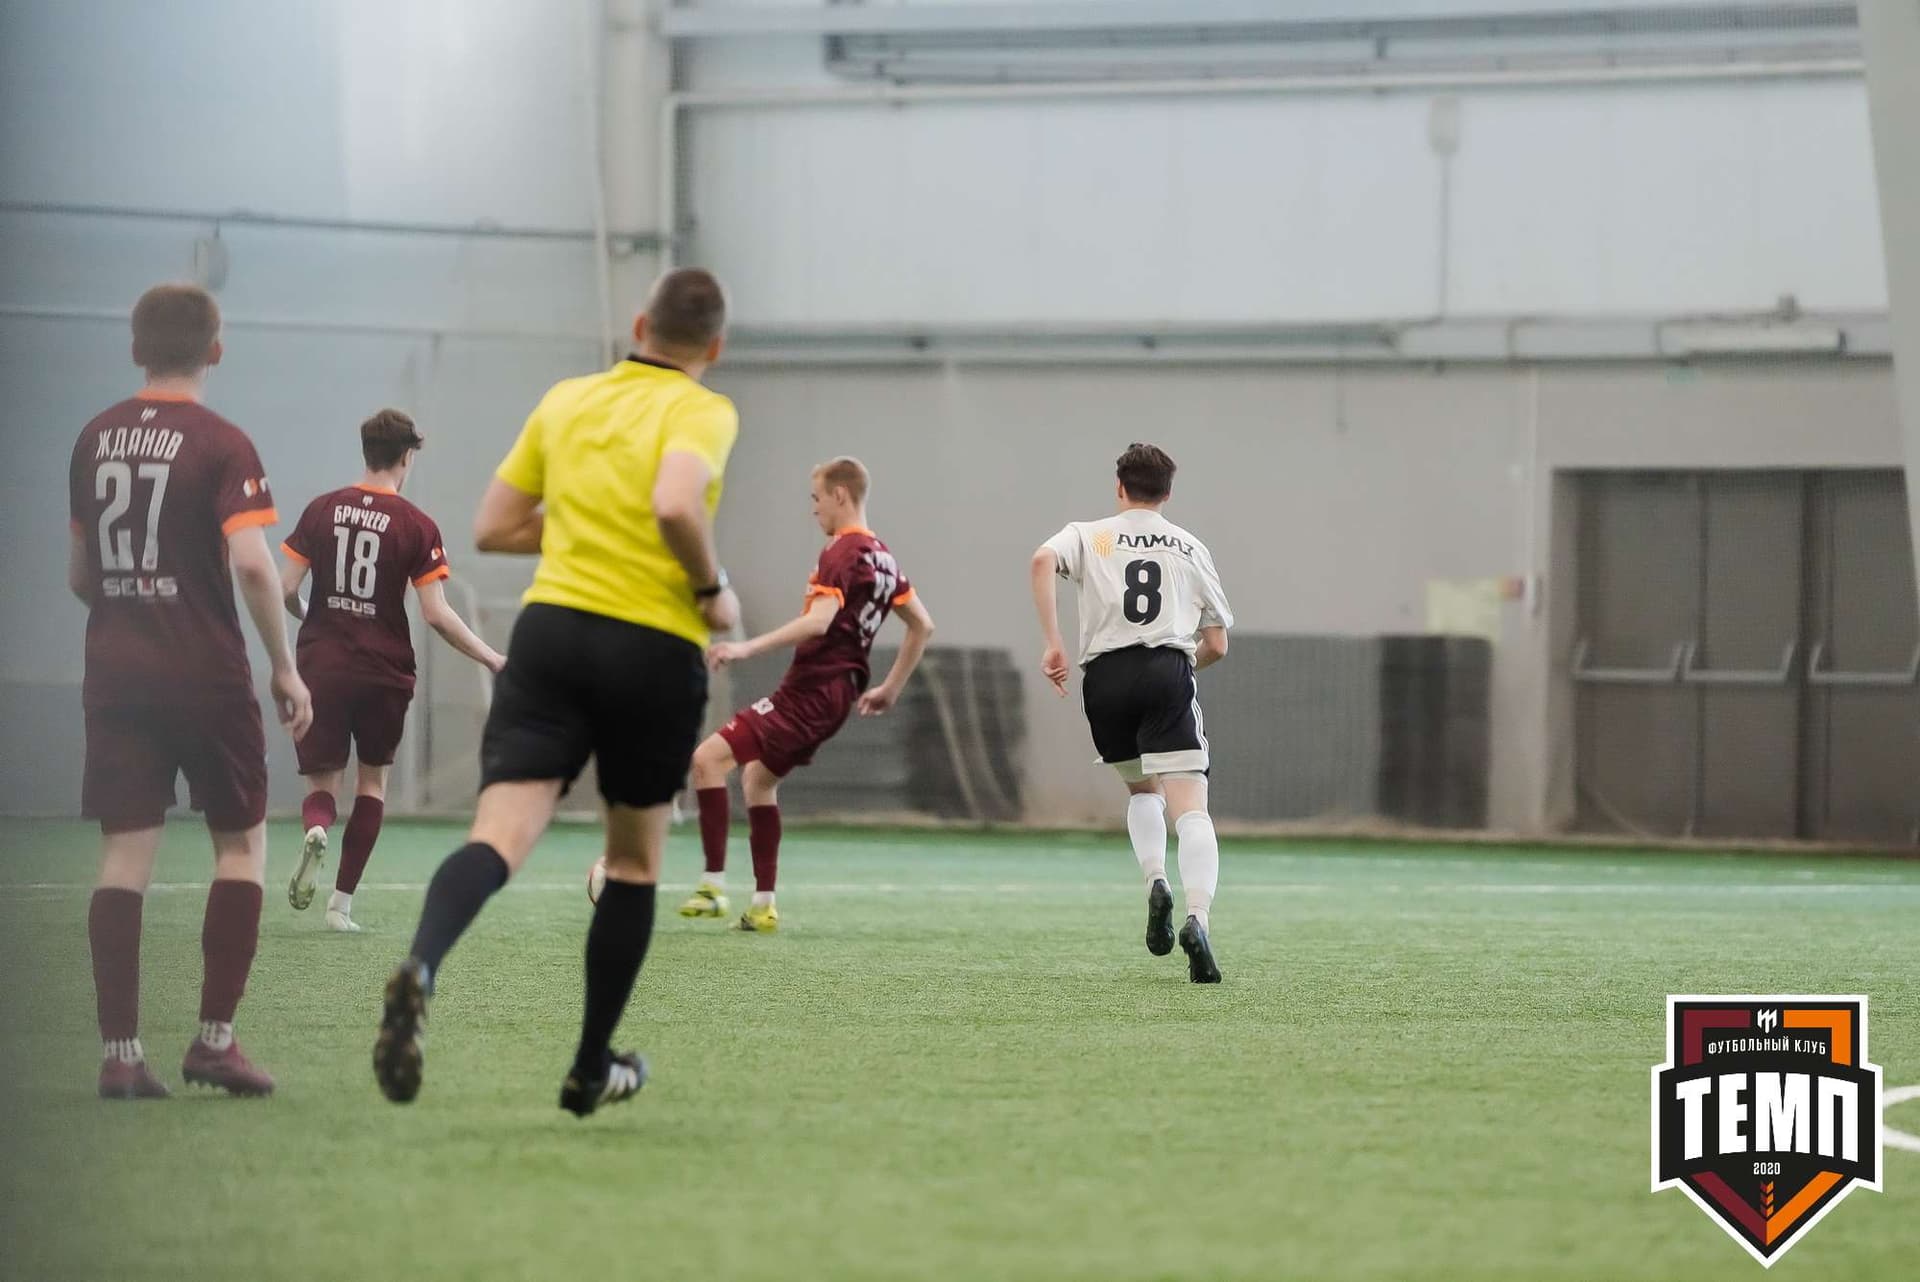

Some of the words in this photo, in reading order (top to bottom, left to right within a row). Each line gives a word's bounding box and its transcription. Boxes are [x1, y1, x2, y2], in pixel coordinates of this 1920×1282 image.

[96, 427, 184, 461] ЖДАНОВ
[95, 461, 170, 571] 27
[333, 526, 381, 600] 18
[1123, 559, 1162, 626] 8
